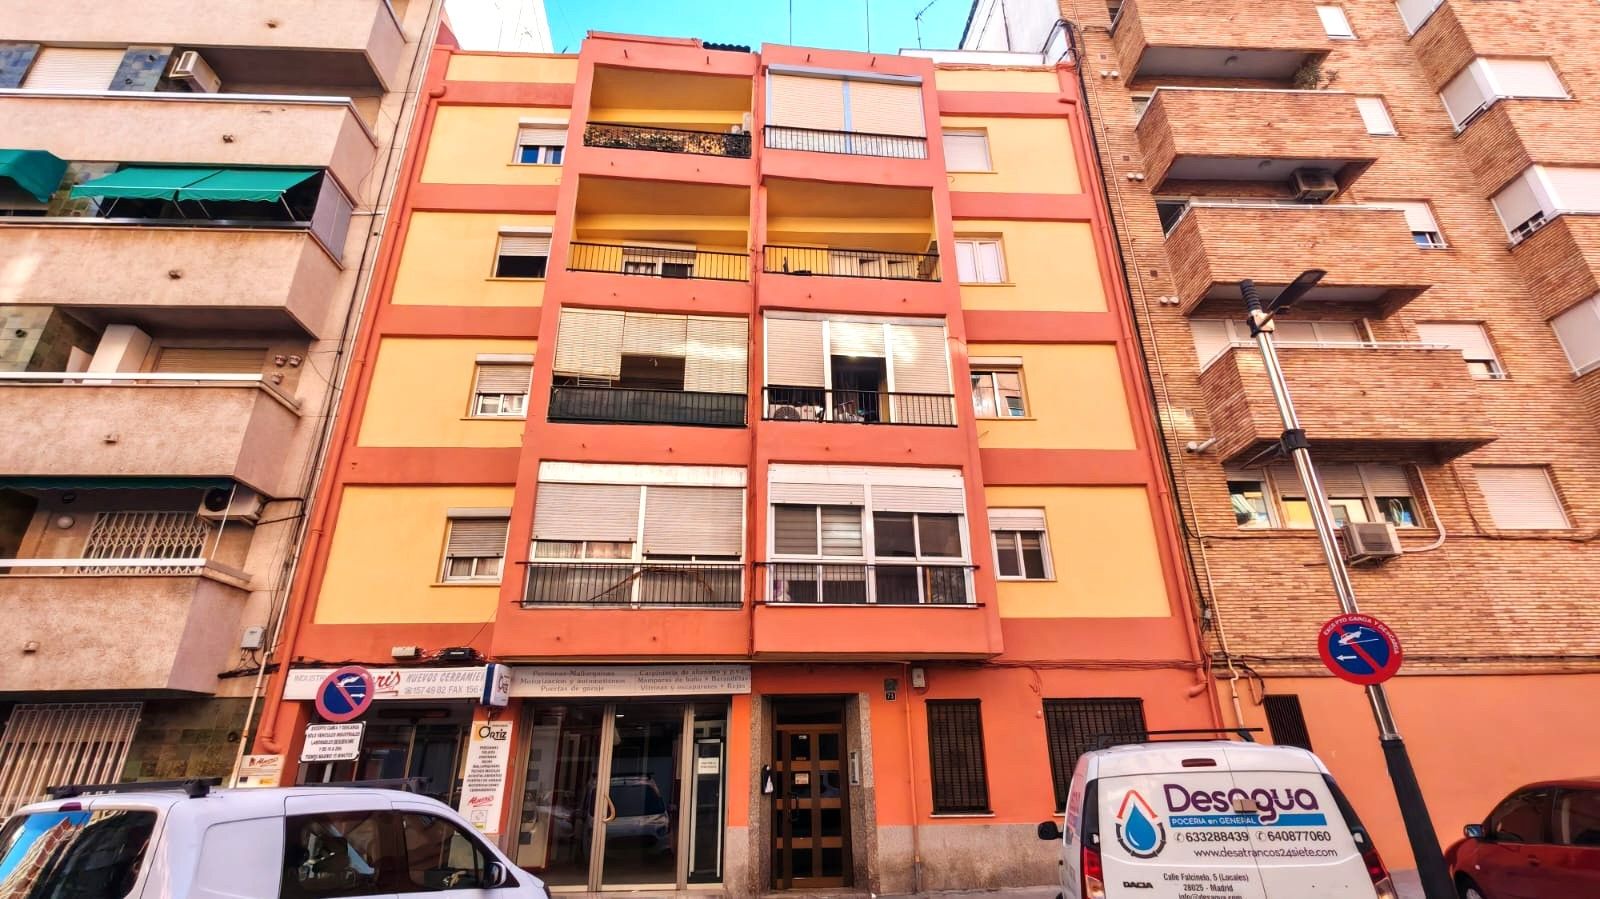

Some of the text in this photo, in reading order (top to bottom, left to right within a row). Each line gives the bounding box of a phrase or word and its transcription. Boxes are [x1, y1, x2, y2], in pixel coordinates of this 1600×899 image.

[1323, 617, 1347, 636] EXCEPTO
[1348, 616, 1372, 624] CARGA
[1378, 624, 1400, 655] DESCARGA
[407, 671, 438, 683] NUEVOS
[448, 686, 463, 694] FAX
[1163, 783, 1319, 823] Desagua
[1171, 817, 1207, 826] POCERIA
[1219, 816, 1257, 825] GENERAL
[1185, 830, 1332, 842] 633288439 640877060
[1193, 846, 1338, 858] www.desatrancos24siete.com
[1163, 872, 1180, 881] Calle
[1212, 873, 1218, 881] 5
[1219, 872, 1249, 882] (Locales)
[1123, 881, 1154, 889] DACIA
[1183, 883, 1204, 892] 28025
[1209, 883, 1234, 892] Madrid
